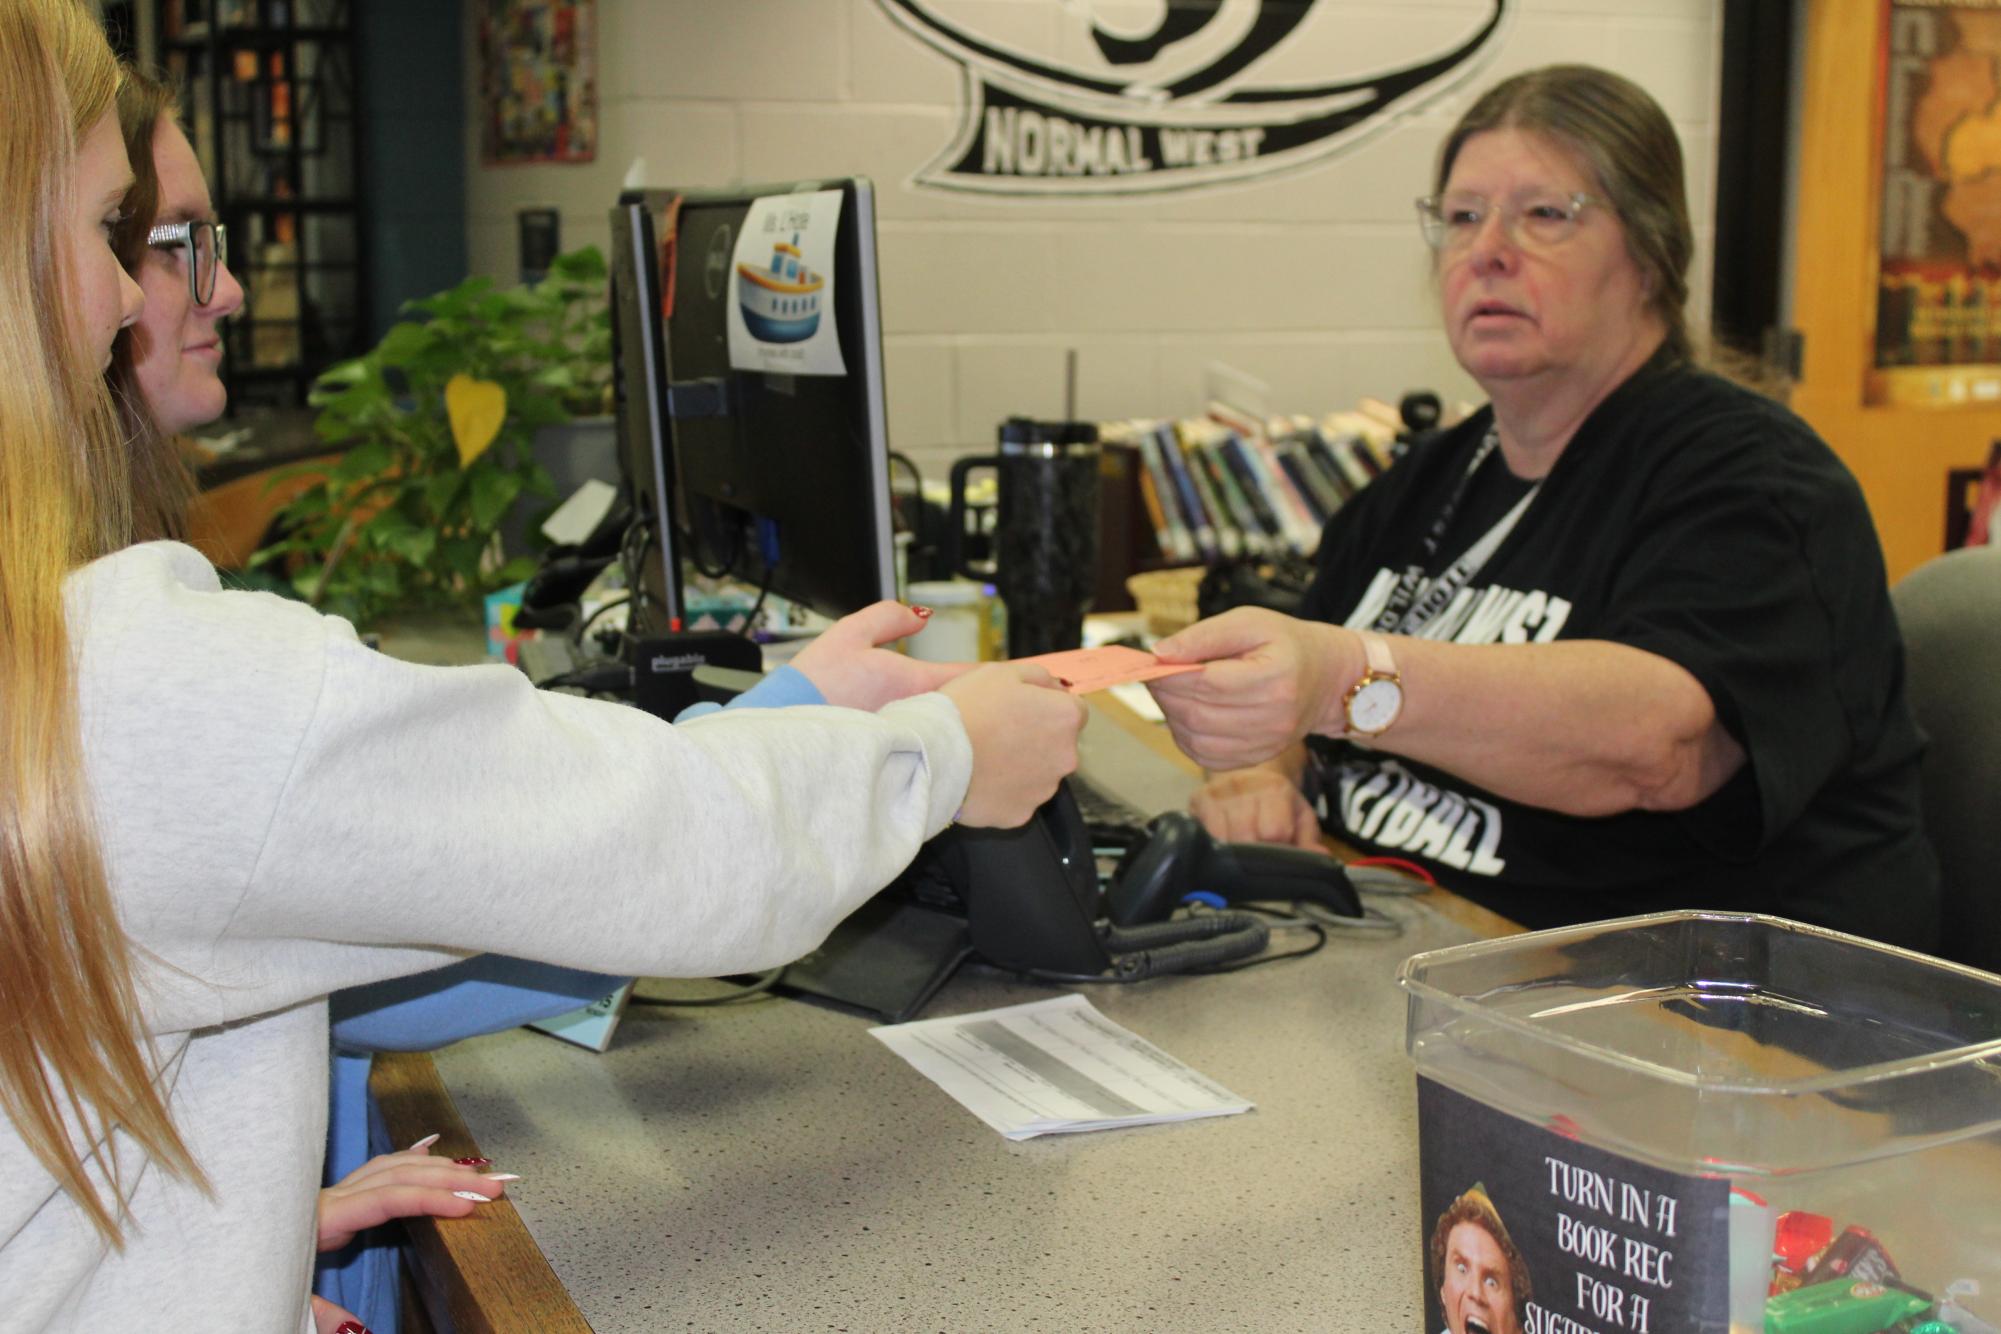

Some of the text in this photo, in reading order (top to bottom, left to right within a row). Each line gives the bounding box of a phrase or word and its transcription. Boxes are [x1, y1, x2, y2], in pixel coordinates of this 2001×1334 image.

[983, 106, 1267, 175] NORMAL WEST
[1545, 1156, 1678, 1238] TURN IN A
[1557, 1212, 1673, 1289] BOOK REC
[1576, 1271, 1650, 1334] FOR A
